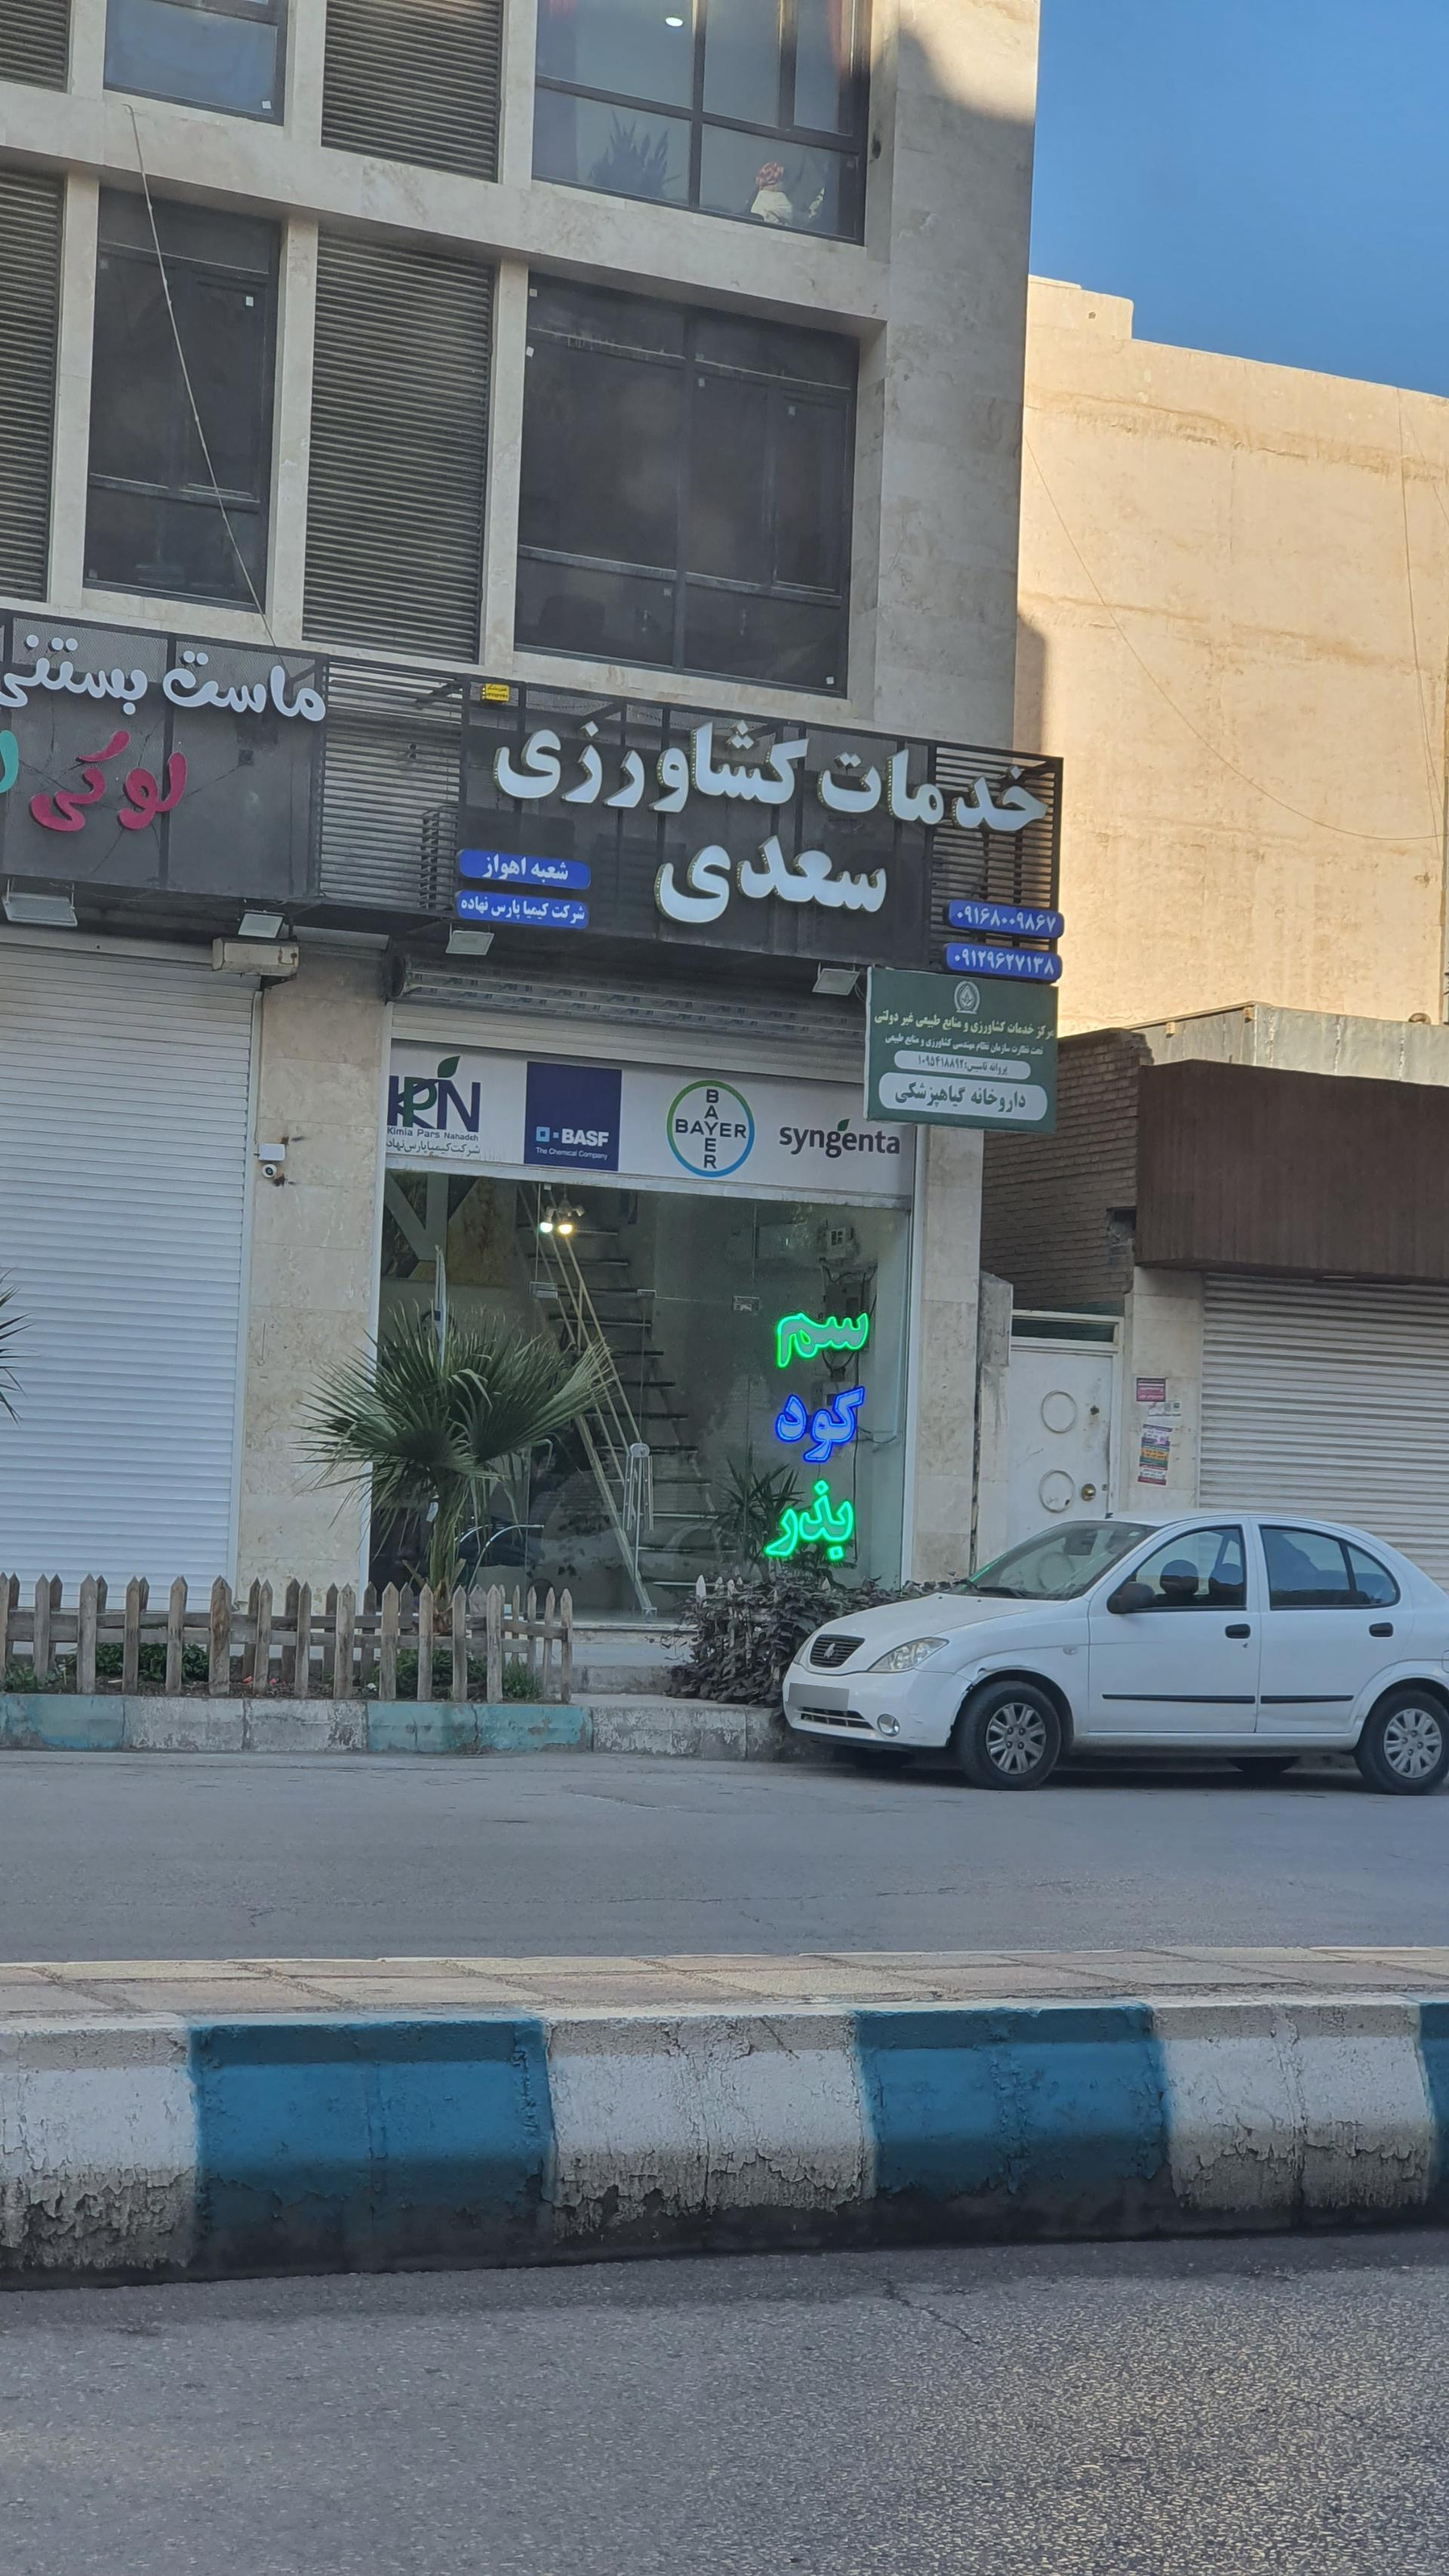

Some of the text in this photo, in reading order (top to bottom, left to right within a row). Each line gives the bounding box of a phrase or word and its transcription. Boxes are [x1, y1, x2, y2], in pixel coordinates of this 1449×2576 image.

[163, 651, 326, 722] ماست
[493, 719, 1049, 832] خدمات کشاورزی
[482, 854, 569, 883] شعبه اهواز
[654, 835, 888, 924] سعدی
[460, 896, 586, 924] شرکت کیمیا پارس نهاده
[957, 905, 1057, 933] ۰۹۱۶۸۰۰۹۸۶۷
[954, 948, 1055, 975] ۰۹۱۲۹۶۲۷۱۳۸
[874, 1009, 1054, 1040] مرکز خدمات کشاورزی و منابع طبیعی غیر دولتی
[884, 1033, 904, 1044] طبیعی
[905, 1035, 919, 1045] منابع
[920, 1039, 924, 1047] و
[925, 1037, 952, 1048] کشاورزی
[952, 1040, 976, 1051] مهندسی
[990, 1042, 1011, 1054] سازمان
[1011, 1045, 1029, 1056] نظارت
[989, 1062, 1008, 1075] پروانه
[895, 1082, 1026, 1113] داروخانه گیاهپزشکی
[386, 1126, 414, 1136] Kimia
[417, 1128, 441, 1138] Pars
[561, 1128, 610, 1147] BASF
[675, 1119, 746, 1139] BAYER
[703, 1088, 719, 1170] BAYER
[404, 1140, 428, 1153] پارس
[426, 1140, 451, 1154] کیمیا
[451, 1143, 481, 1157] شرکت
[779, 1126, 900, 1159] syngenta
[536, 1146, 608, 1161] The Chemical Company
[776, 1310, 869, 1369] سم
[774, 1384, 867, 1463] کود
[764, 1479, 855, 1562] بذر
